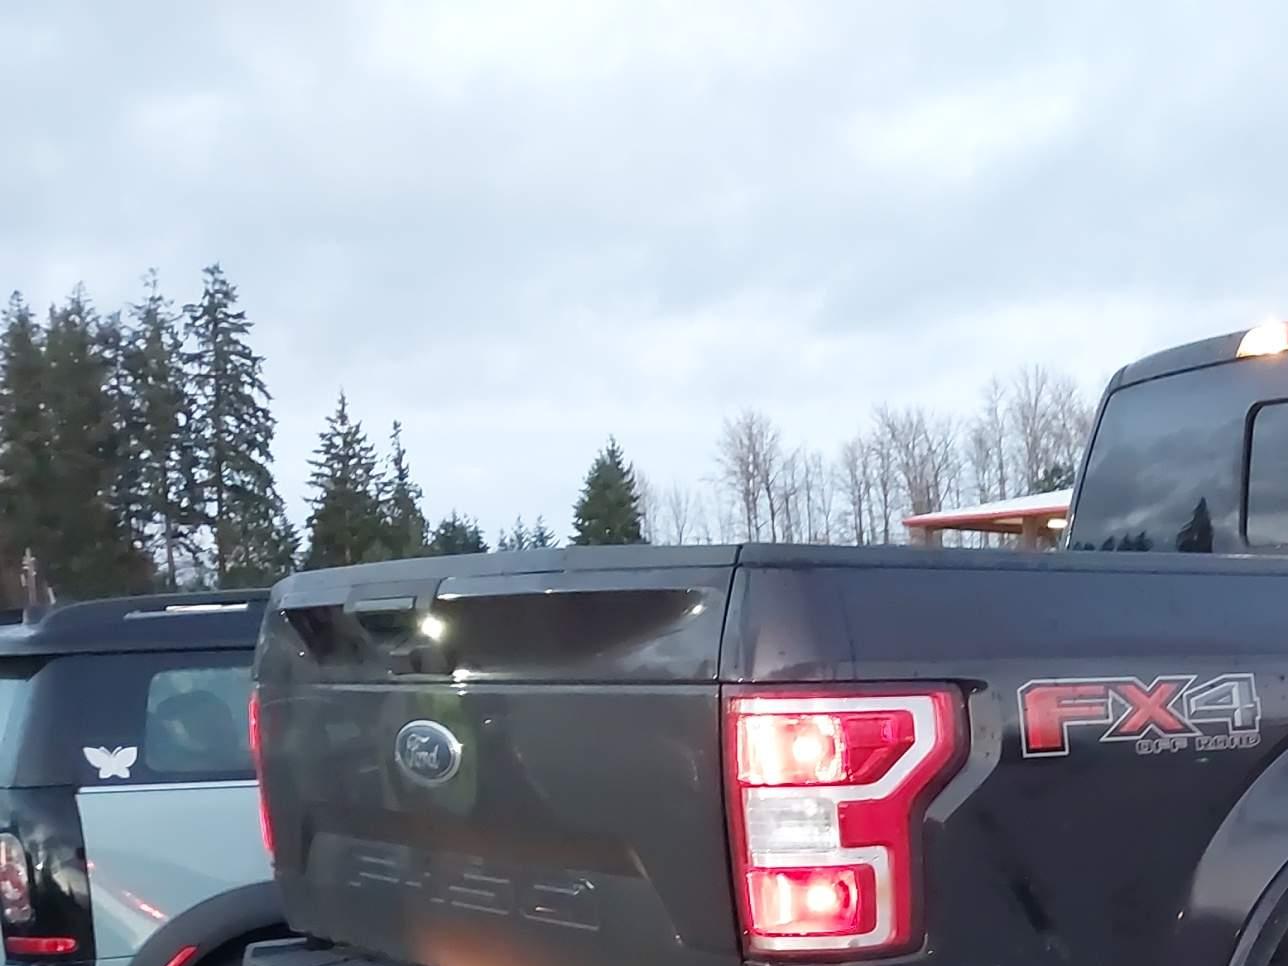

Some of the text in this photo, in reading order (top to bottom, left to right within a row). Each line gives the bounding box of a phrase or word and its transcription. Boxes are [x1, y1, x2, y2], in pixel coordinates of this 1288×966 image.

[1017, 673, 1262, 758] FX4
[405, 733, 441, 769] Ford
[1135, 733, 1260, 755] OFF ROAD
